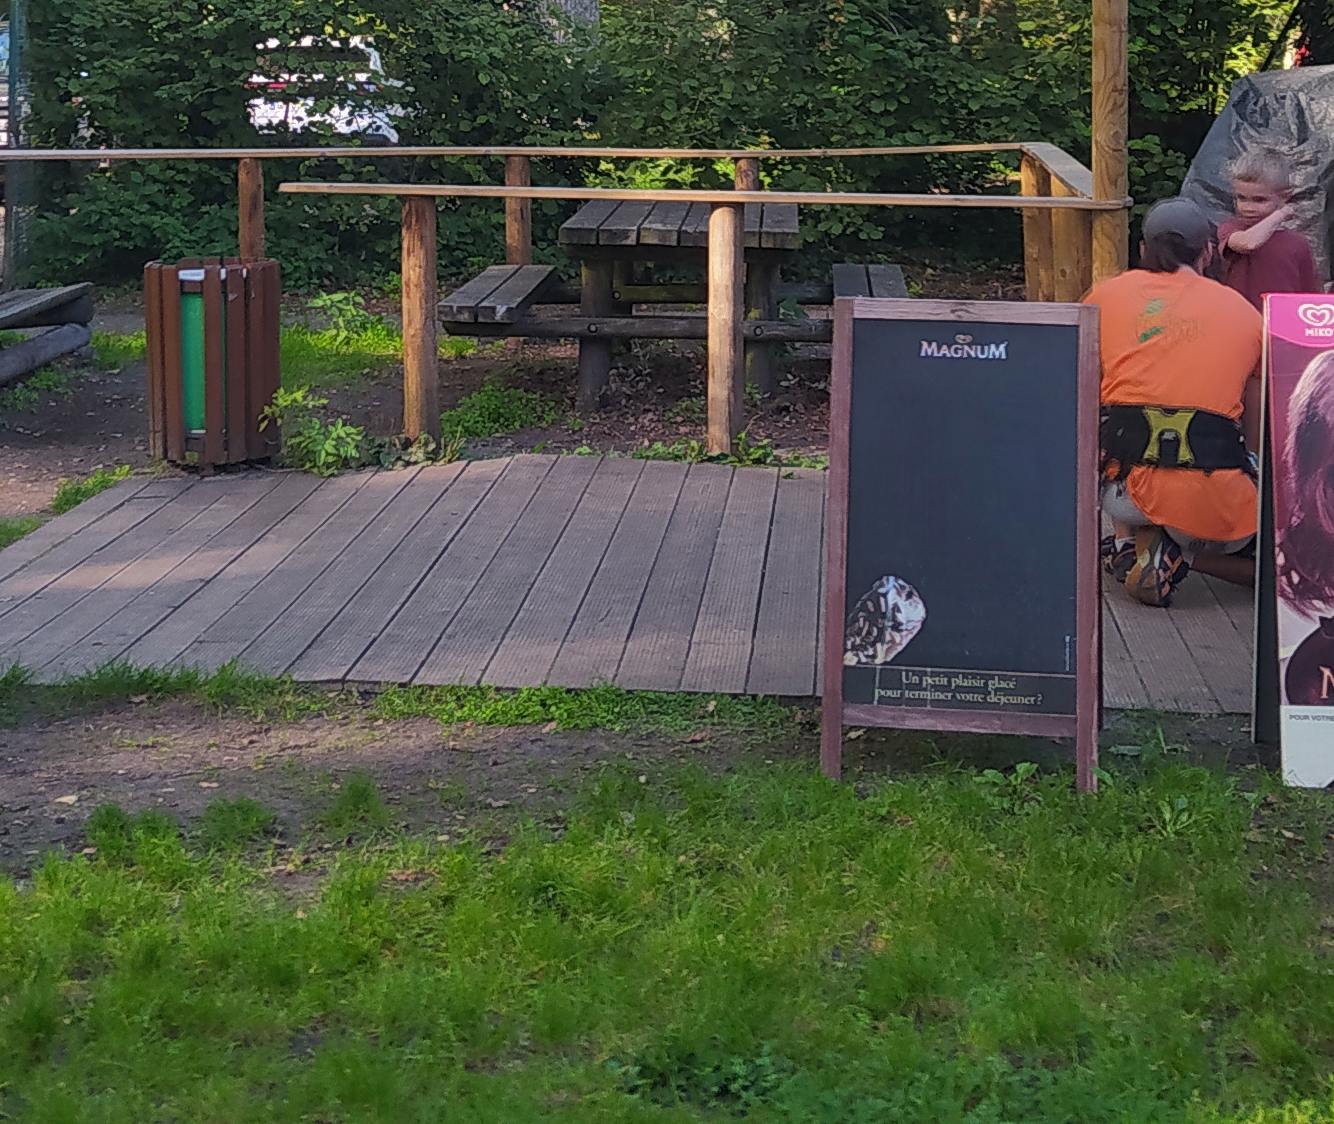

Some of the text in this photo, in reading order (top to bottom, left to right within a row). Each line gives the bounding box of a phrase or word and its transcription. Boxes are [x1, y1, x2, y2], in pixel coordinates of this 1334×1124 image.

[1304, 327, 1334, 337] MIKO
[902, 671, 1017, 692] Un petit plaisir glacé
[875, 688, 902, 701] pour
[904, 688, 954, 701] terminer
[955, 692, 985, 703] votre
